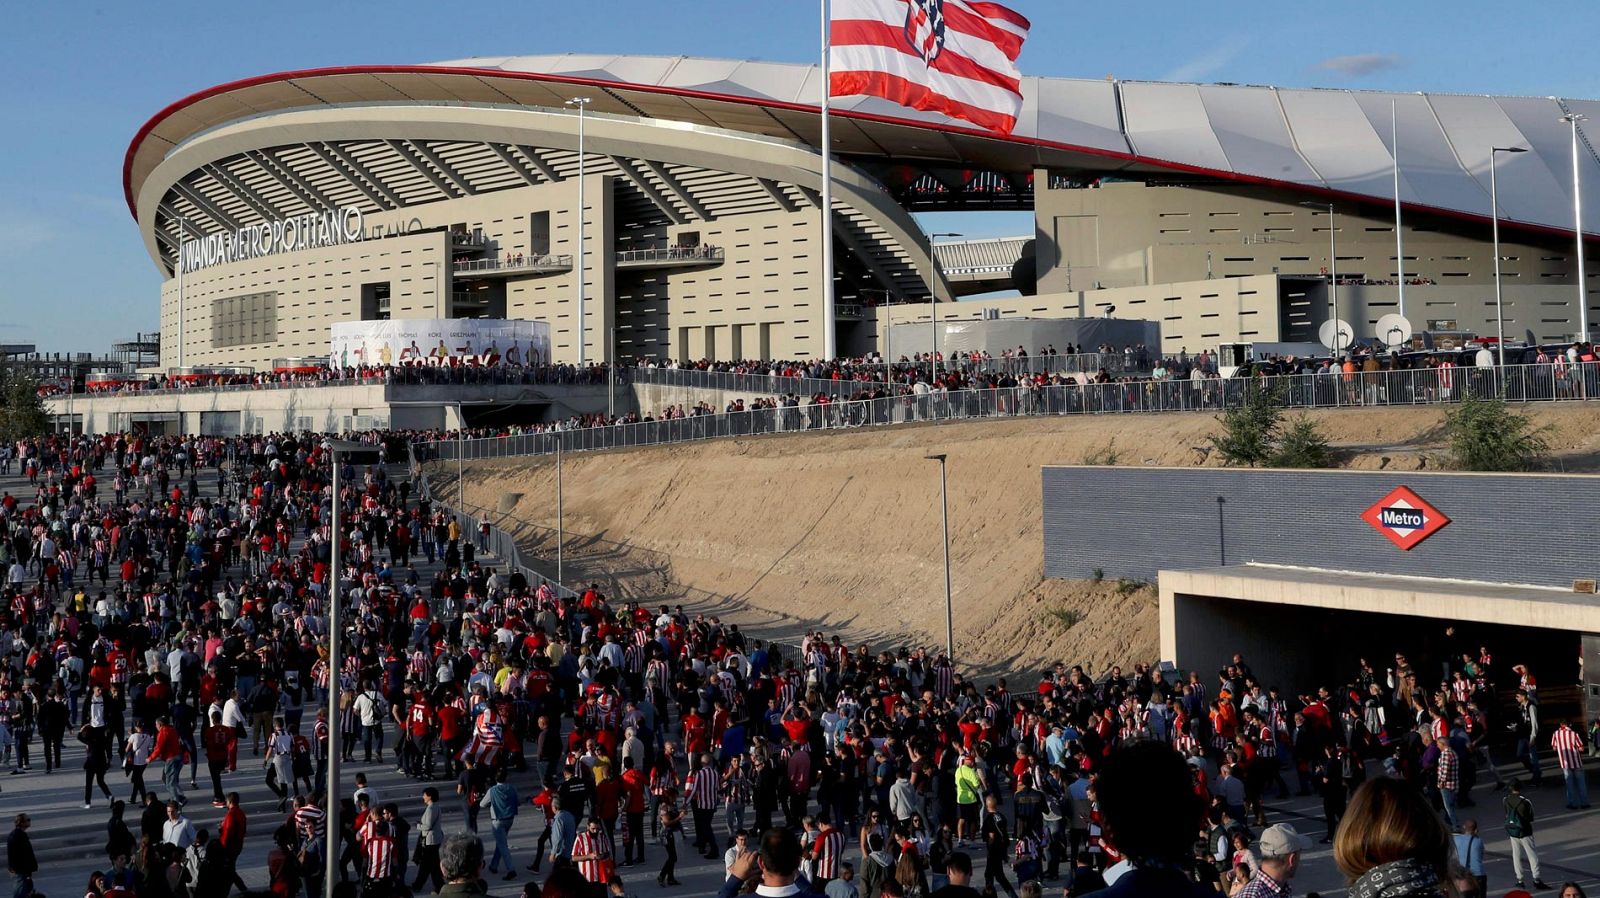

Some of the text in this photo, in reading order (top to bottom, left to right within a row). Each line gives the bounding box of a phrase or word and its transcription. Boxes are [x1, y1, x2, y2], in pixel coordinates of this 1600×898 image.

[185, 206, 362, 272] WANDA METROPOLITANO
[1384, 510, 1421, 526] Metro
[114, 657, 127, 670] 29
[413, 708, 424, 723] 14
